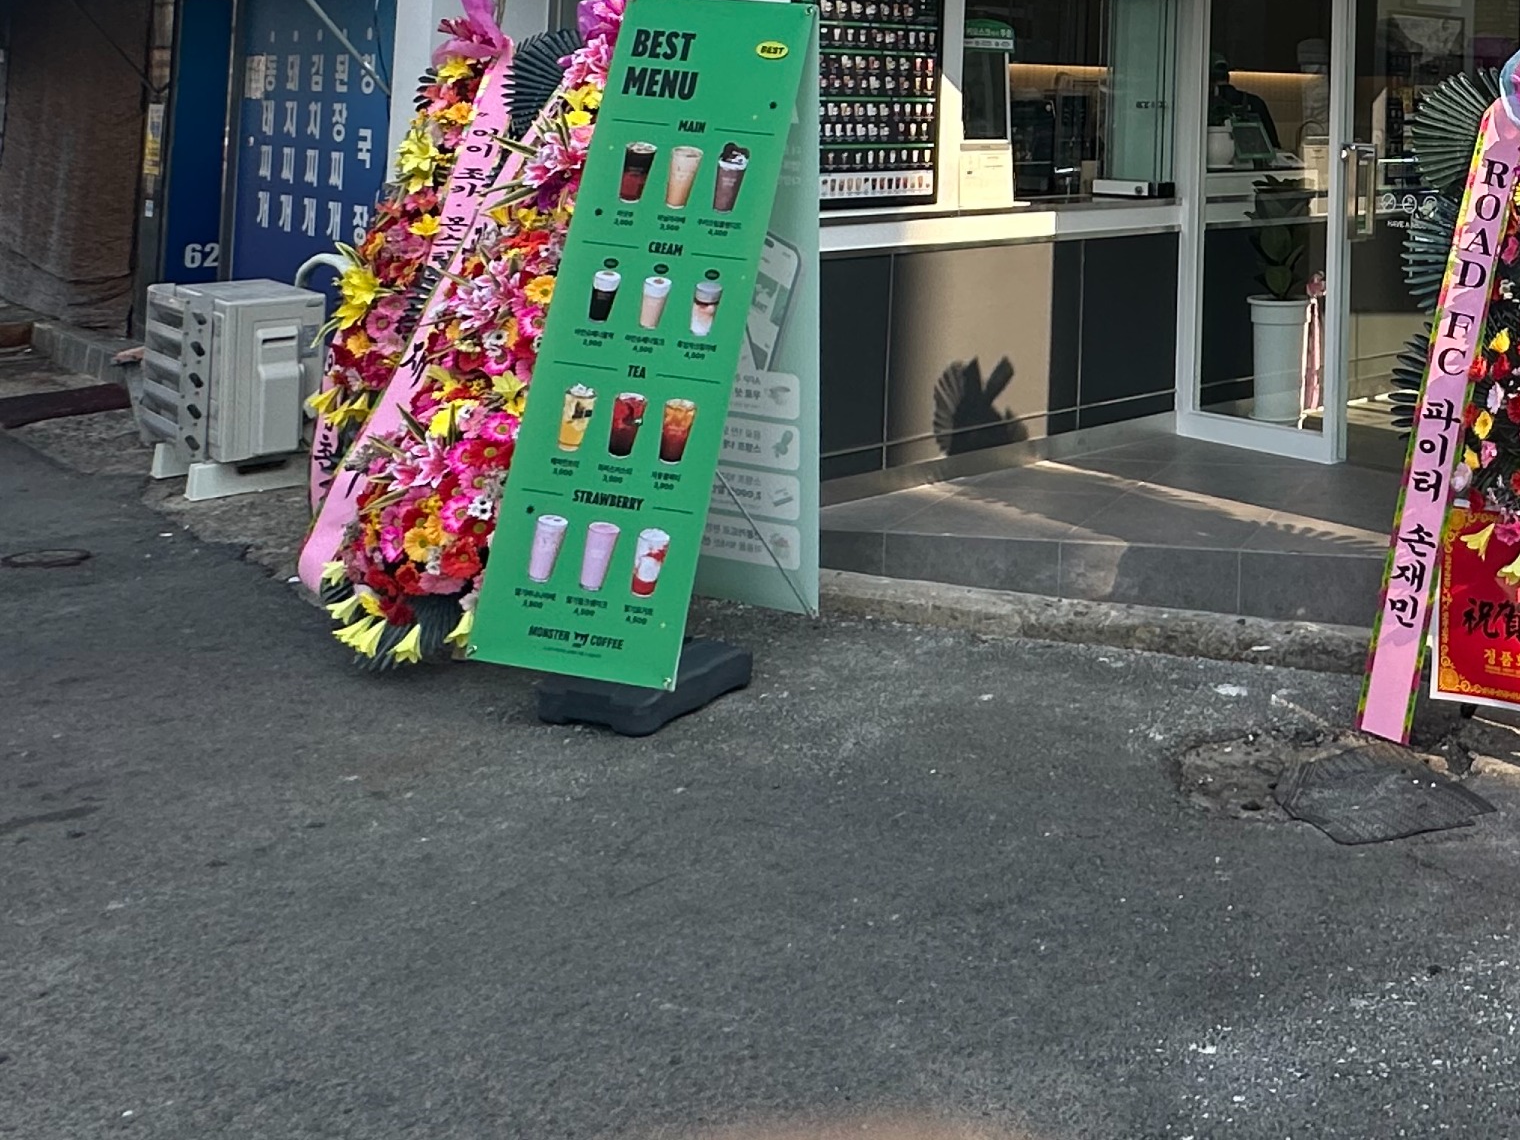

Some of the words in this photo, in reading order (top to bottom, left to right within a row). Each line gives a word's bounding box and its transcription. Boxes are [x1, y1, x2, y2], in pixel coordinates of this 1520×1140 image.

[630, 28, 697, 62] BEST
[760, 45, 785, 55] BEST
[621, 66, 700, 101] MENU
[678, 120, 707, 134] MAIN
[301, 54, 325, 238] 김치찌개
[325, 54, 350, 242] 된장찌개
[1457, 157, 1511, 291] ROAD
[184, 243, 220, 269] 62
[648, 241, 684, 257] CREAM
[1438, 311, 1476, 377] FC
[627, 364, 647, 379] TEA
[1412, 399, 1461, 504] 파이터
[572, 489, 645, 511] STRAWBERRY
[1389, 524, 1437, 629] 손재민
[528, 625, 571, 643] MONSTER
[589, 634, 625, 650] COFFEE
